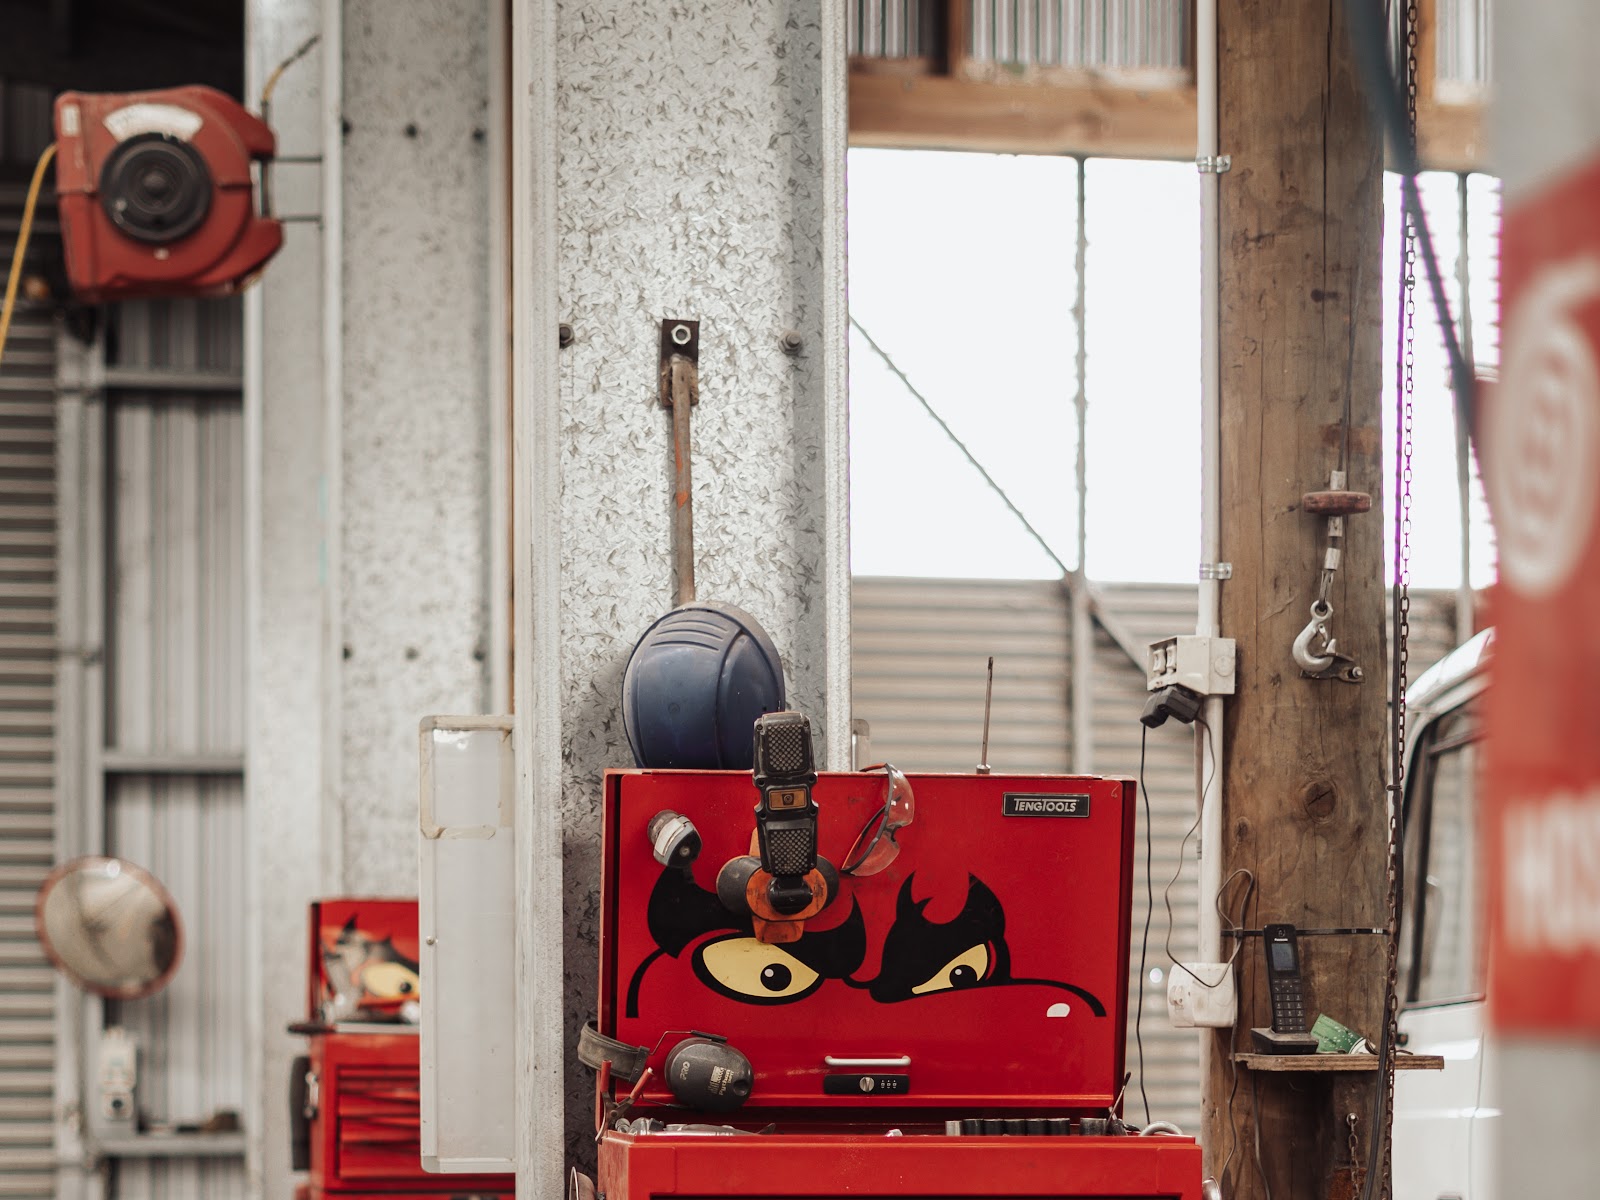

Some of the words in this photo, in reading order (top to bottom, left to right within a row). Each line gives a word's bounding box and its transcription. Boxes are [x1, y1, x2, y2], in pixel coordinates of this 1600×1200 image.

[1013, 798, 1077, 812] TENGTOOLS
[680, 1061, 690, 1080] PRO
[719, 1069, 731, 1095] Python
